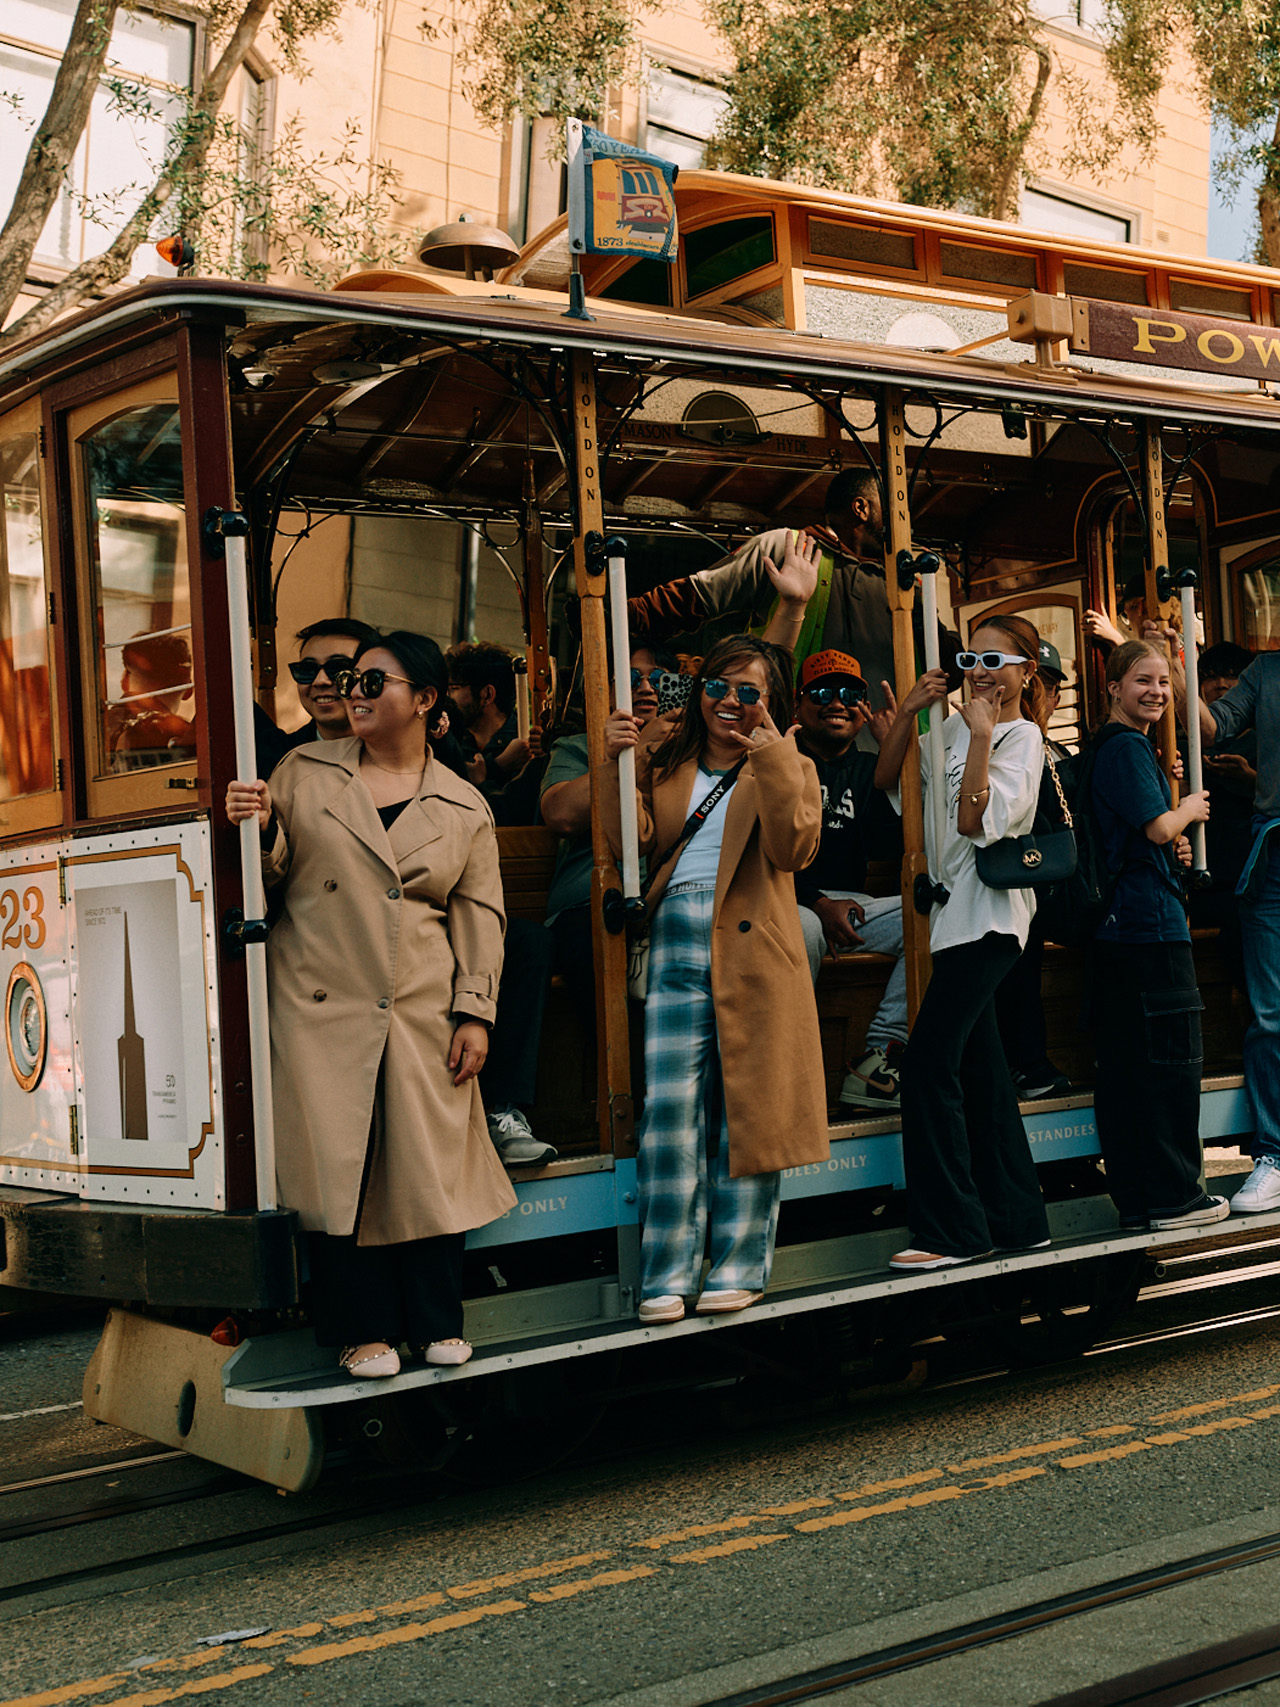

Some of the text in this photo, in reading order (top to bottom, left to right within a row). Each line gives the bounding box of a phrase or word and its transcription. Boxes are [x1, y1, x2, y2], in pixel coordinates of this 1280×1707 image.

[597, 237, 624, 247] 1873
[581, 372, 595, 501] HOLD ON
[624, 424, 672, 440] MASON
[776, 437, 809, 454] HYDE
[892, 405, 906, 521] HOLD ON
[1151, 433, 1163, 539] HOLD ON
[700, 785, 725, 813] SONY
[0, 886, 46, 950] 23
[1028, 1123, 1095, 1144] STANDEES
[827, 1155, 867, 1172] ONLY
[520, 1195, 568, 1216] ONLY
